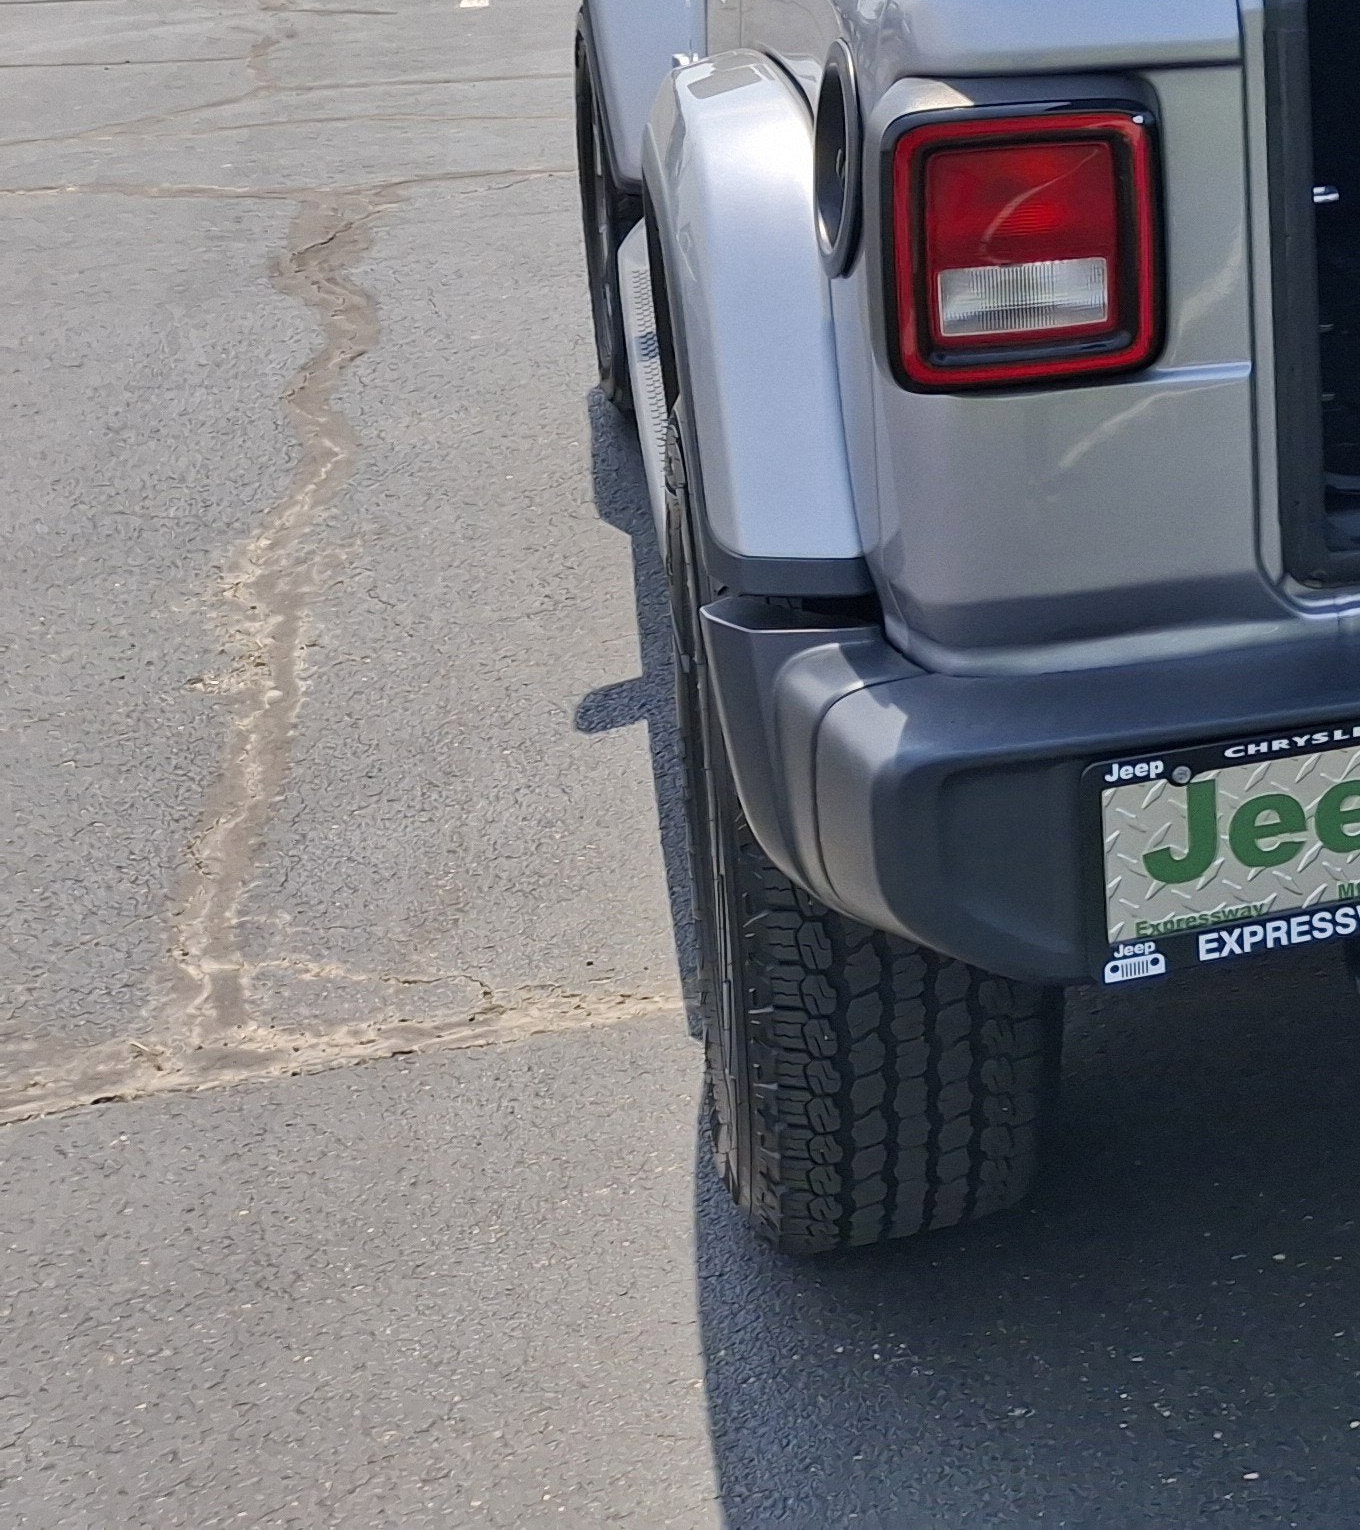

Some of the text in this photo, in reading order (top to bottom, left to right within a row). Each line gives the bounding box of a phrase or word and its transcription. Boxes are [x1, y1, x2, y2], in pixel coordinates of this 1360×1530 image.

[1104, 760, 1164, 783] Jeep
[1135, 901, 1265, 938] Expressway
[1113, 941, 1156, 958] Jeep
